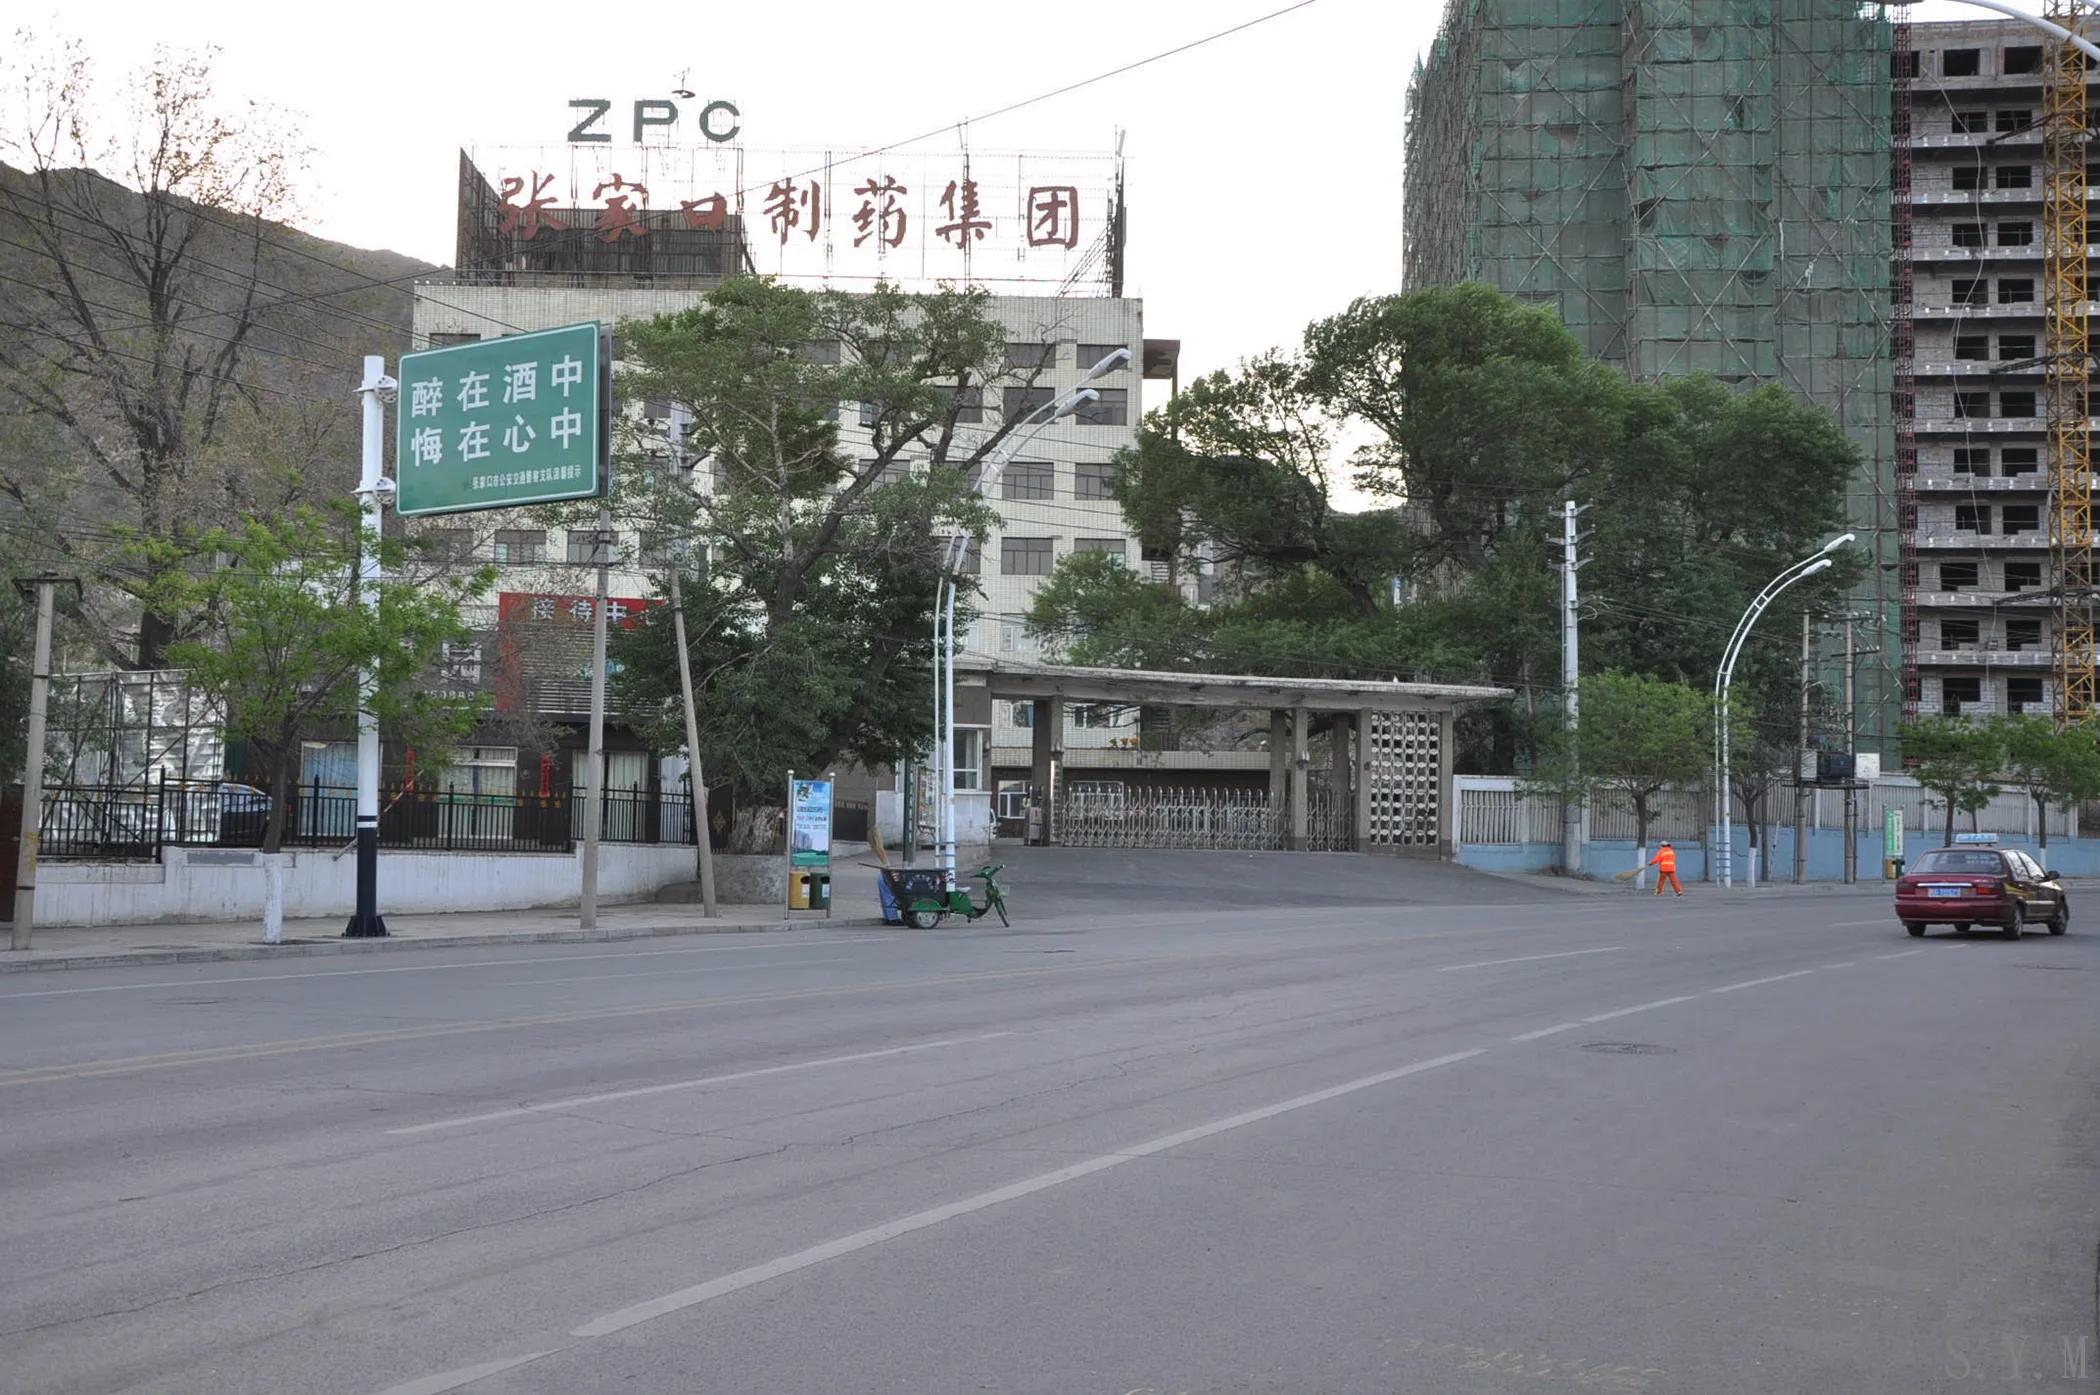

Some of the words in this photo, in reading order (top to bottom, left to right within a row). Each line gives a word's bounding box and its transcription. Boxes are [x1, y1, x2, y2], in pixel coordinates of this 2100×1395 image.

[567, 99, 741, 143] ZPC
[500, 168, 1079, 251] 张家口制药集团
[411, 355, 583, 418] 醉在酒中
[411, 407, 582, 467] 悔在心中
